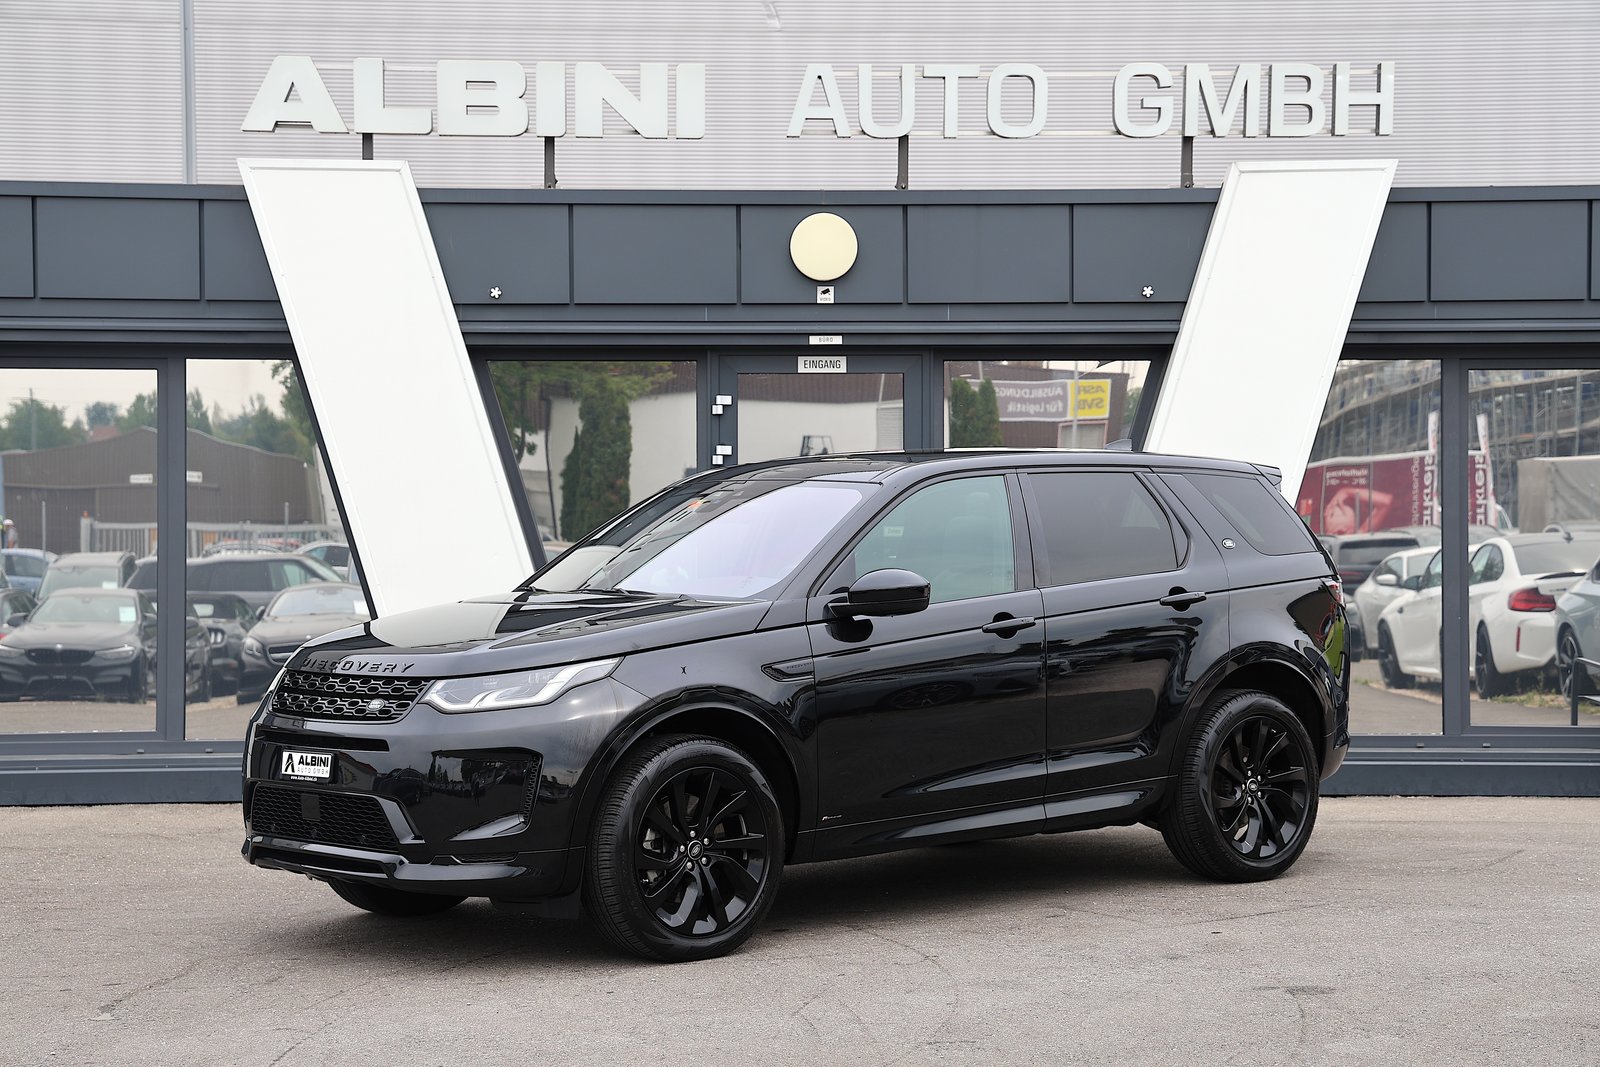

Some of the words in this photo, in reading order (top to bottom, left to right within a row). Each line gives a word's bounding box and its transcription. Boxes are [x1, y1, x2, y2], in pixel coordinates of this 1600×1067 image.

[241, 55, 706, 139] ALBINI
[787, 62, 1048, 138] AUTO
[1112, 61, 1396, 138] GMBH
[803, 359, 841, 369] EINGANG
[302, 658, 416, 674] DISCOVERY
[298, 755, 330, 768] ALBINI
[297, 766, 312, 774] AUTO
